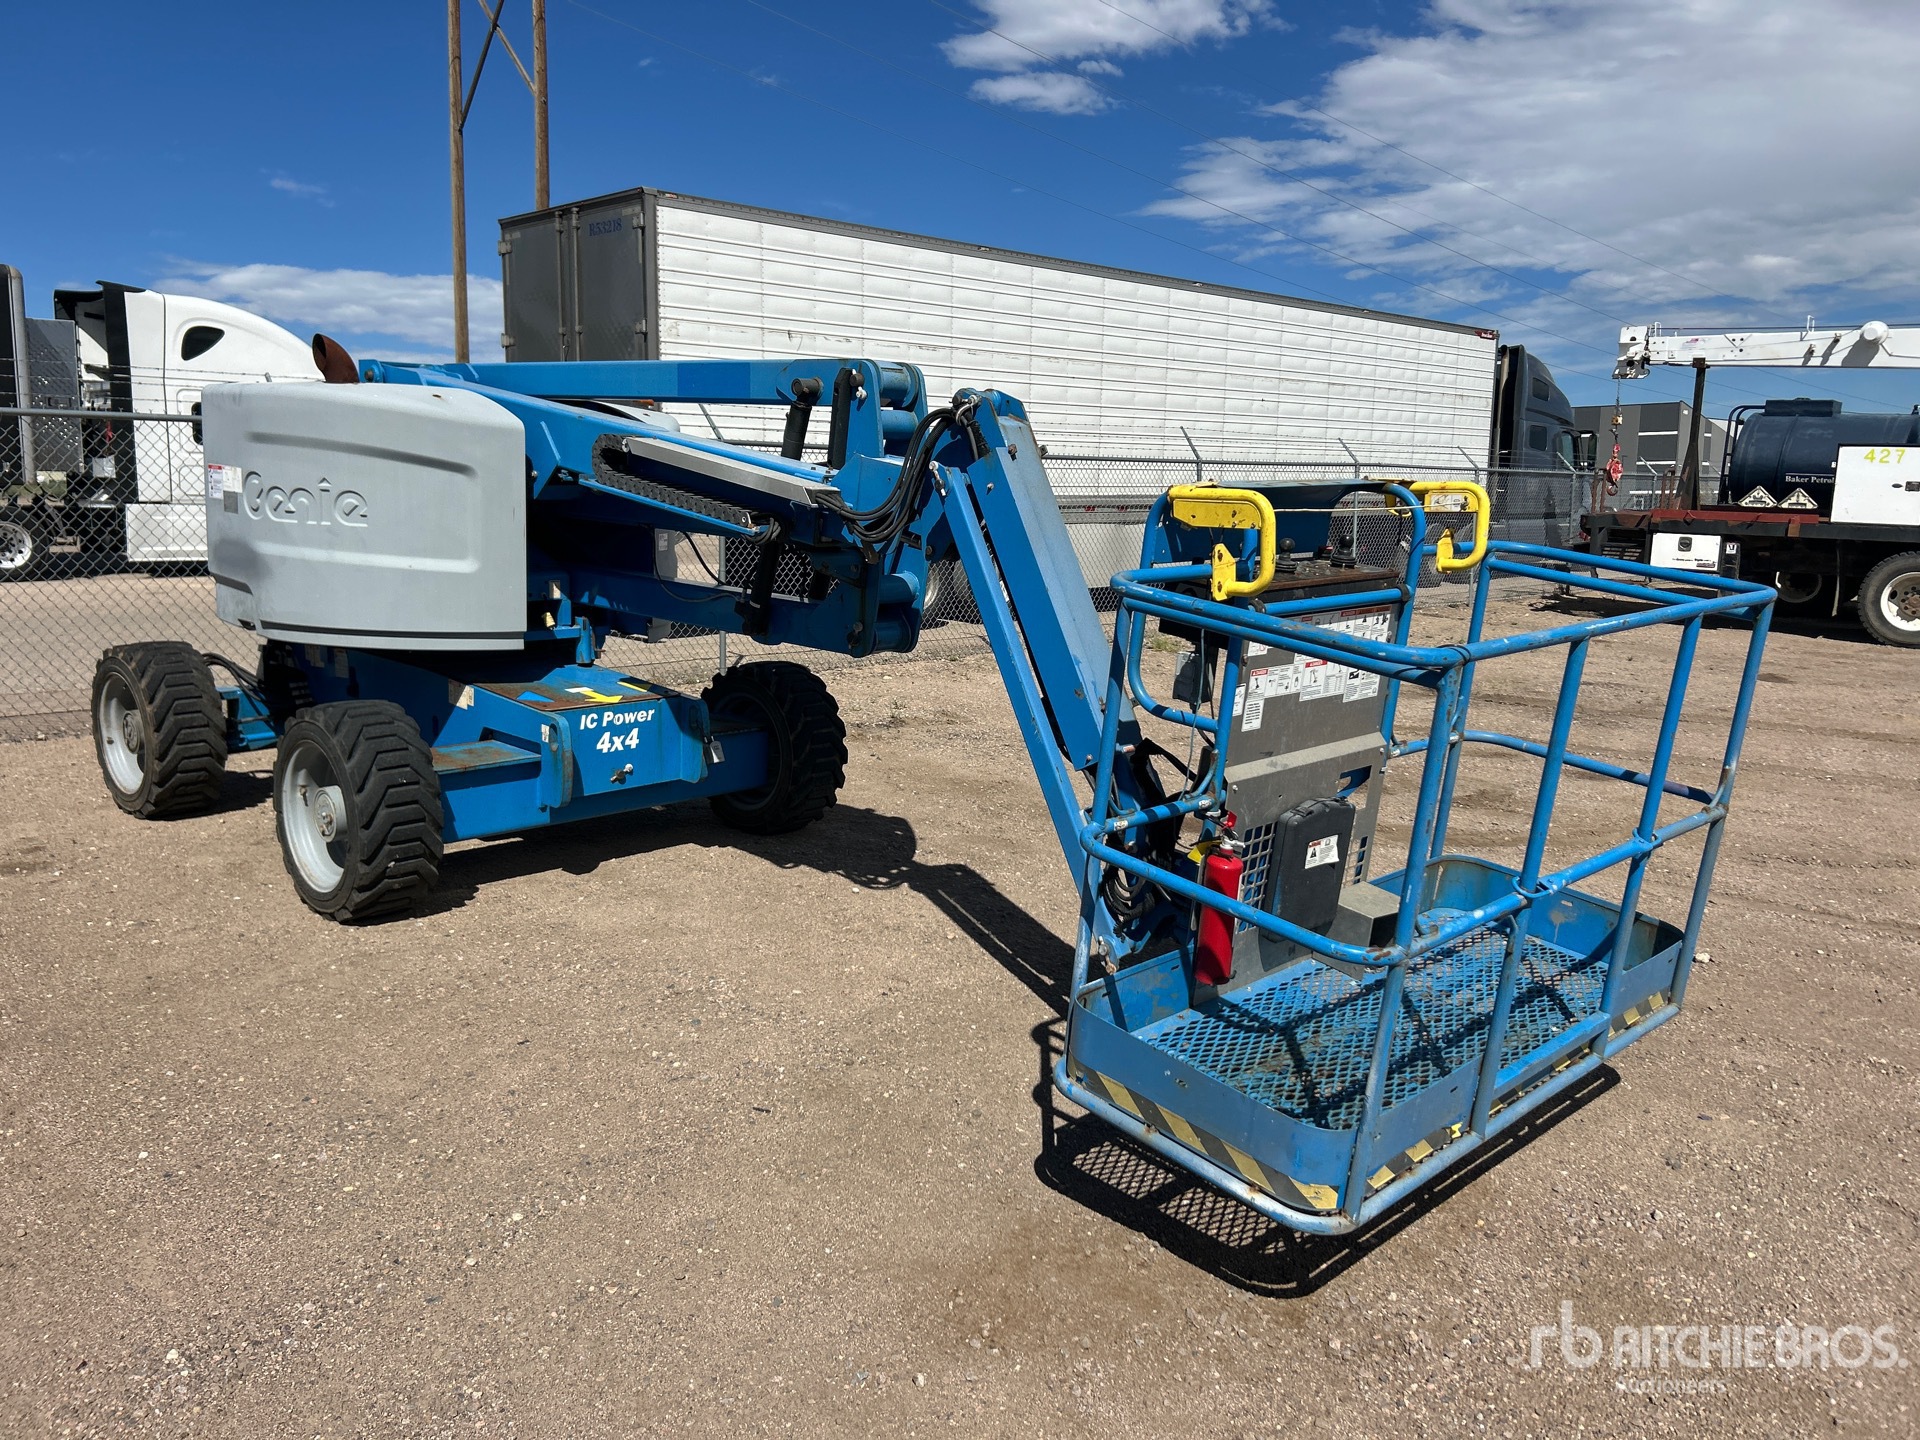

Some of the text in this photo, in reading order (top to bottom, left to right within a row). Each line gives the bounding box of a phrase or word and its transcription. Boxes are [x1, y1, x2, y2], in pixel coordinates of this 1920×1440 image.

[1863, 448, 1906, 464] 427
[1785, 475, 1809, 483] Baker
[243, 470, 369, 527] Genie
[579, 708, 656, 730] IC Power
[596, 727, 640, 754] 4x4
